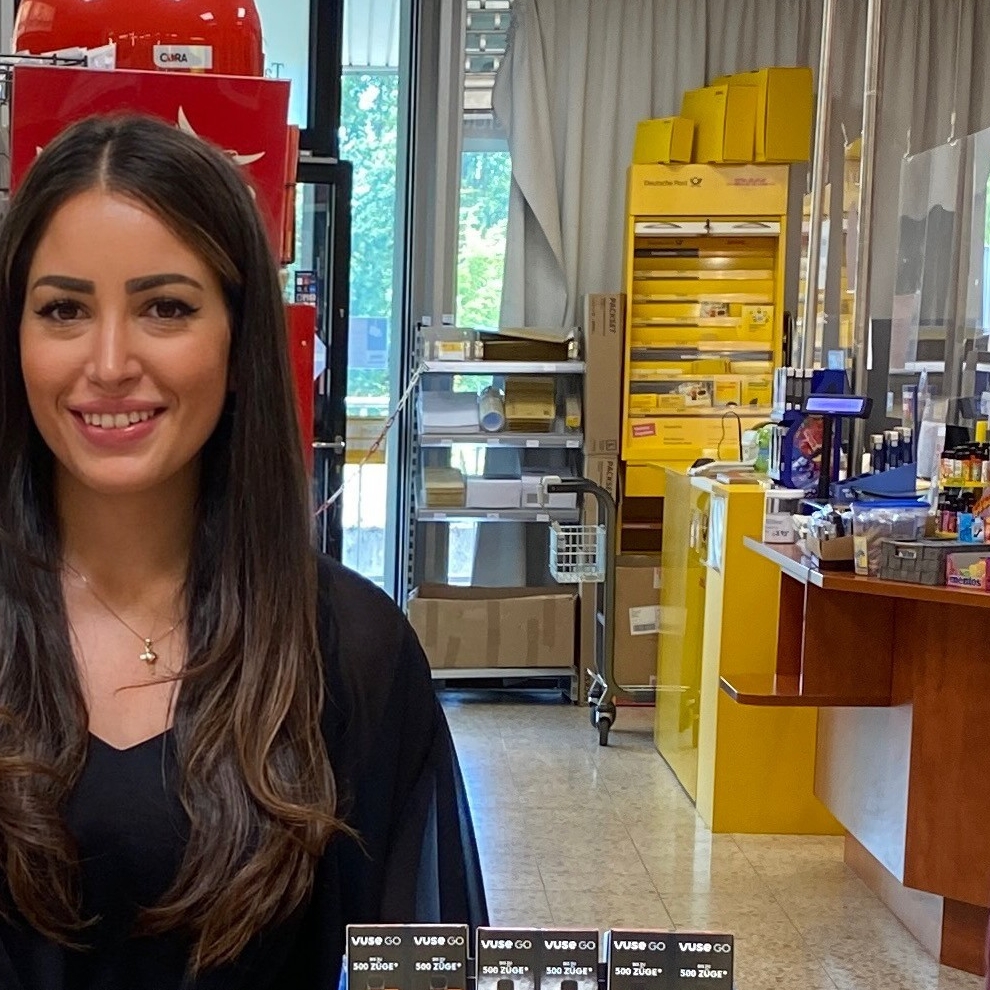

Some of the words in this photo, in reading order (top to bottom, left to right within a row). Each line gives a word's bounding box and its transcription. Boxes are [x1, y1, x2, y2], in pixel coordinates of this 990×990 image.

[384, 936, 402, 946] GO
[447, 936, 464, 946] GO
[515, 940, 532, 950] GO
[578, 940, 596, 950] GO
[648, 942, 666, 951] GO
[713, 944, 731, 953] GO
[353, 962, 369, 971] 500
[416, 962, 432, 971] 500
[483, 966, 498, 974] 500
[546, 966, 562, 974] 500
[615, 968, 631, 976] 500
[680, 970, 696, 978] 500
